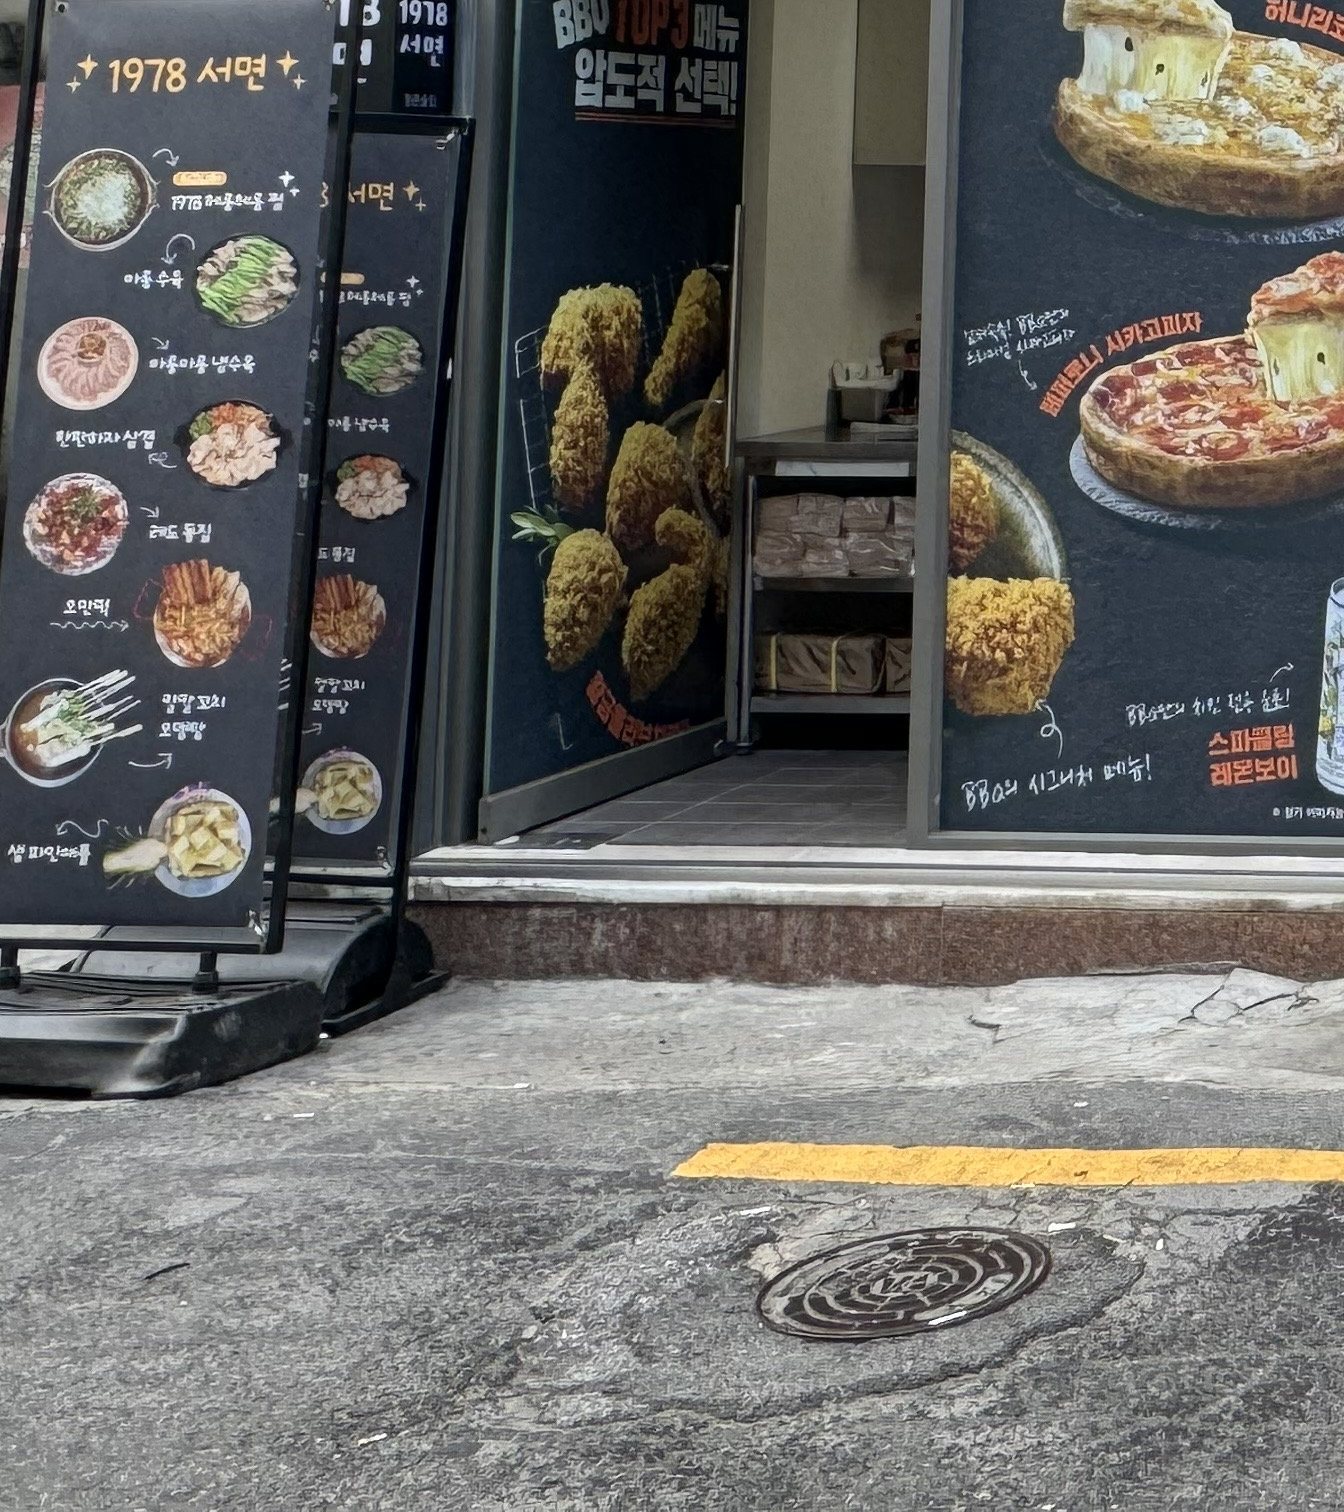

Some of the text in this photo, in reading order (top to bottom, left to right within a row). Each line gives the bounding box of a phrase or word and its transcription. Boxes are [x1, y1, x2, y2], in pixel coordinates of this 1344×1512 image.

[399, 0, 448, 26] 1978
[693, 3, 740, 53] 메뉴
[400, 34, 444, 67] 서면
[109, 53, 266, 93] 1978 서면
[575, 48, 739, 116] 압도적 선택!
[1029, 765, 1093, 795] 시그니처
[1103, 753, 1152, 782] 메뉴!
[1209, 754, 1298, 787] 레몬보이
